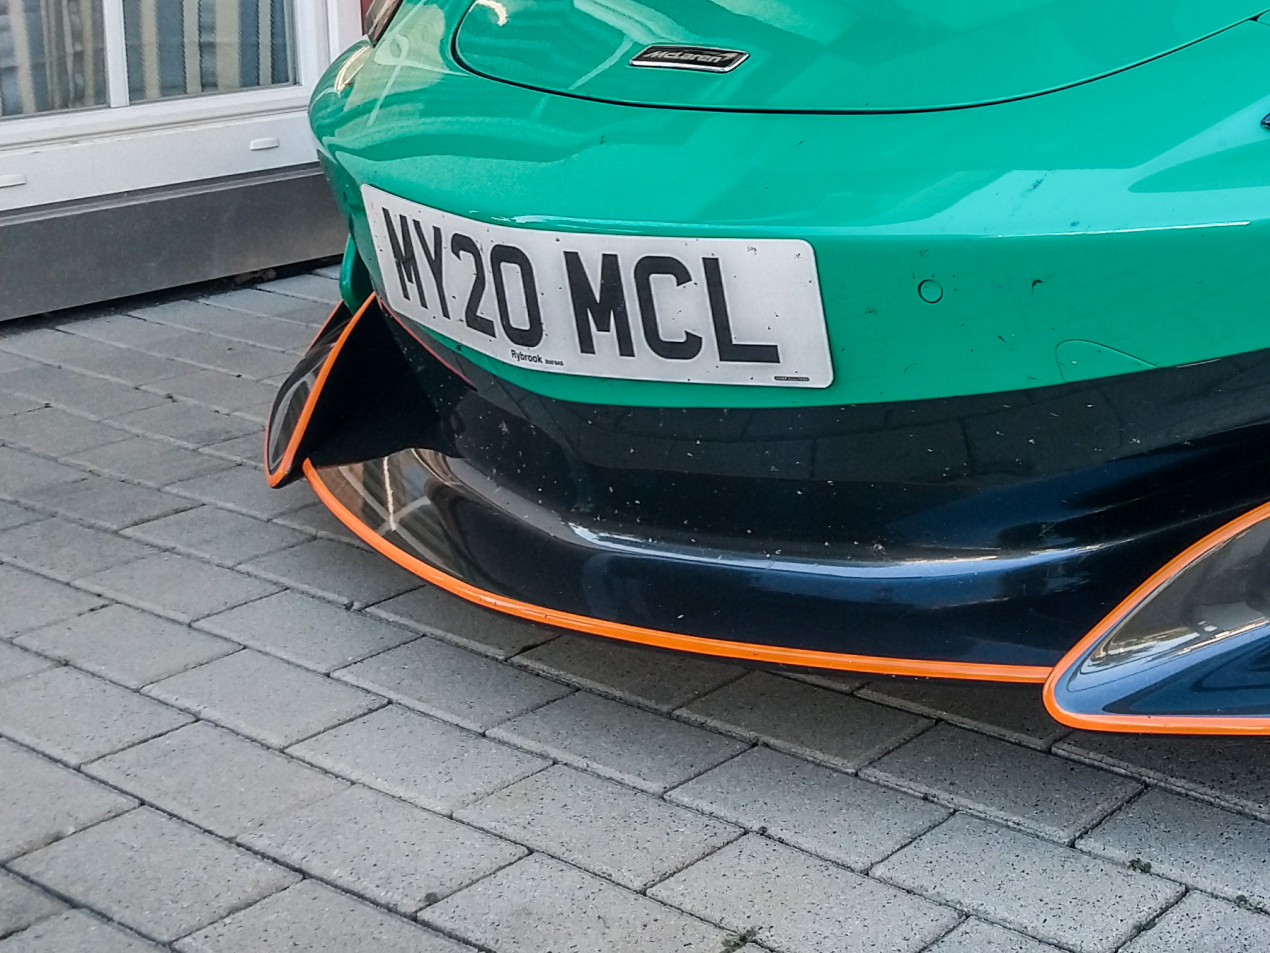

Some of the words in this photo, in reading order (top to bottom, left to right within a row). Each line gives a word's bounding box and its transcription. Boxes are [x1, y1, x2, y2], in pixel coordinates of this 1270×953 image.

[641, 50, 722, 63] McLaren
[382, 207, 543, 347] MY20
[563, 251, 781, 364] MCL
[511, 349, 543, 363] Rybrook
